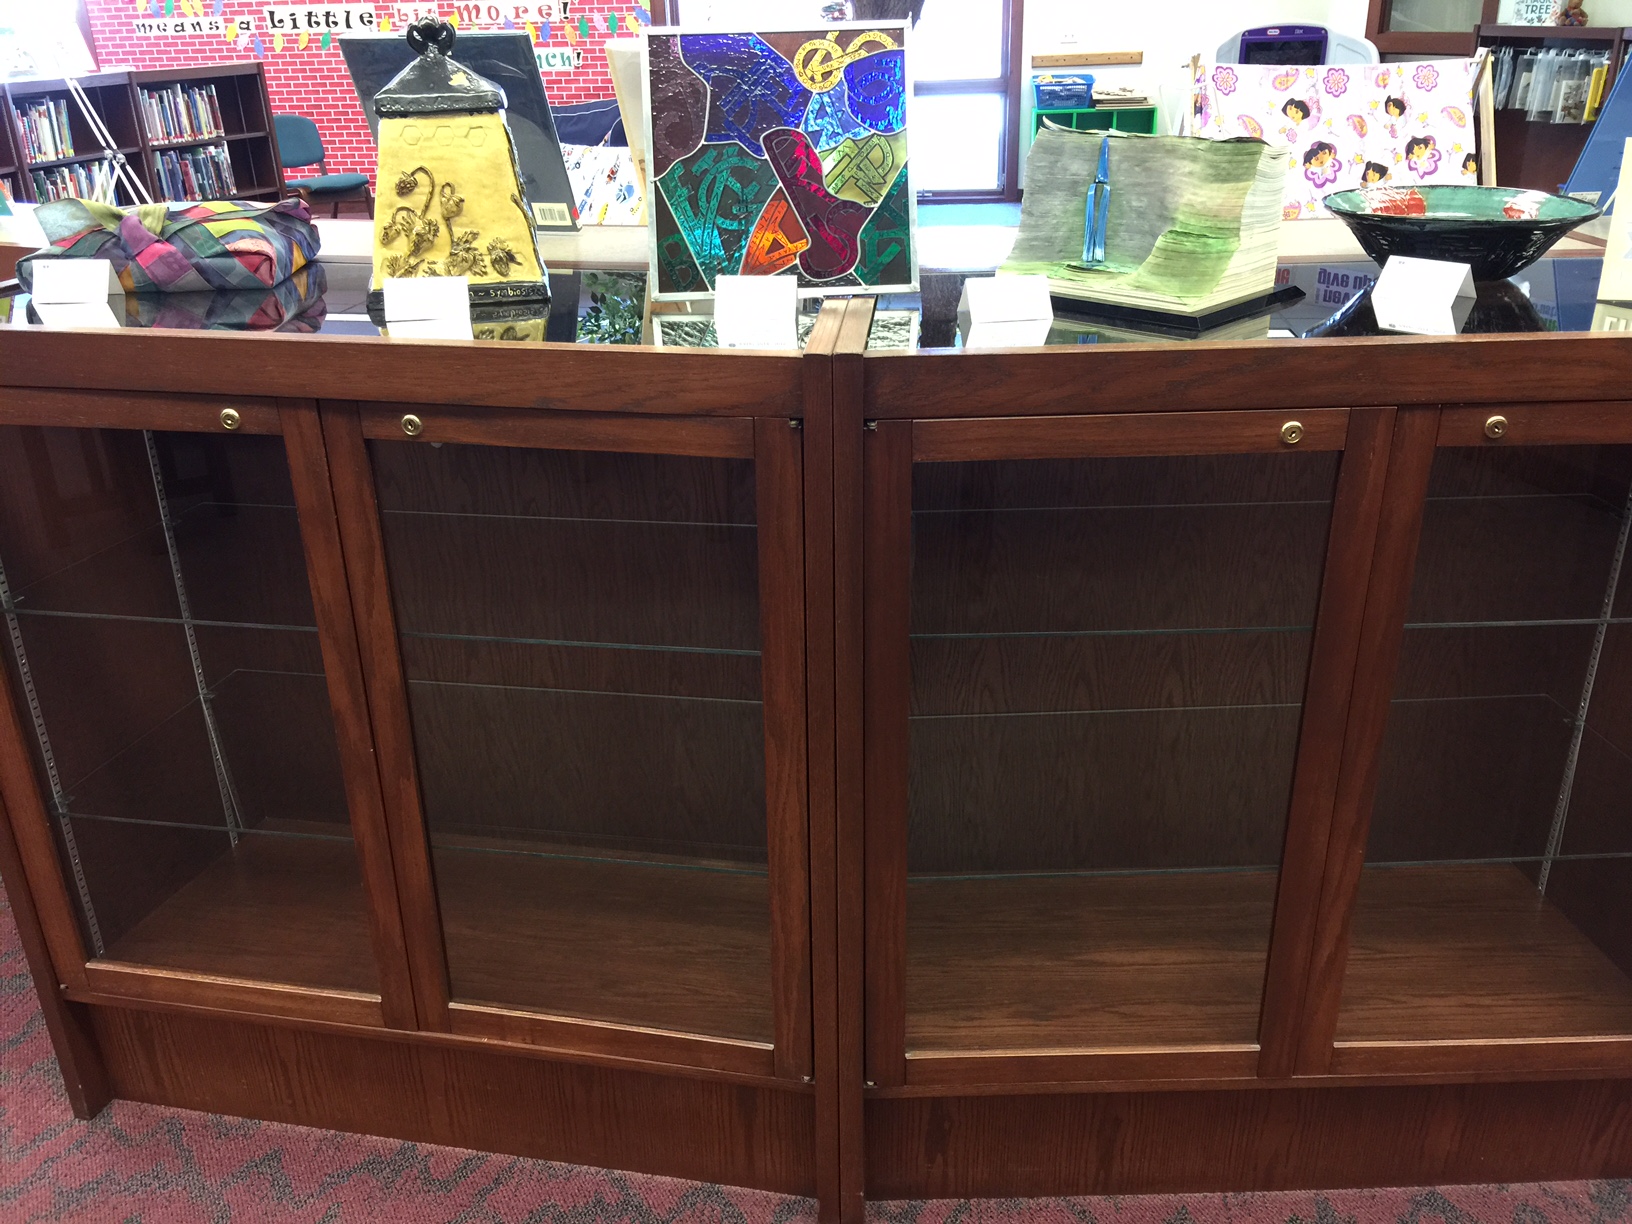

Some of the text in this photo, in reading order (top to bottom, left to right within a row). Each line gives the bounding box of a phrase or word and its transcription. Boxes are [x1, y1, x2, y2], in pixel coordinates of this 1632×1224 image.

[1524, 4, 1552, 15] TREE
[238, 20, 252, 31] a
[266, 10, 374, 30] Little
